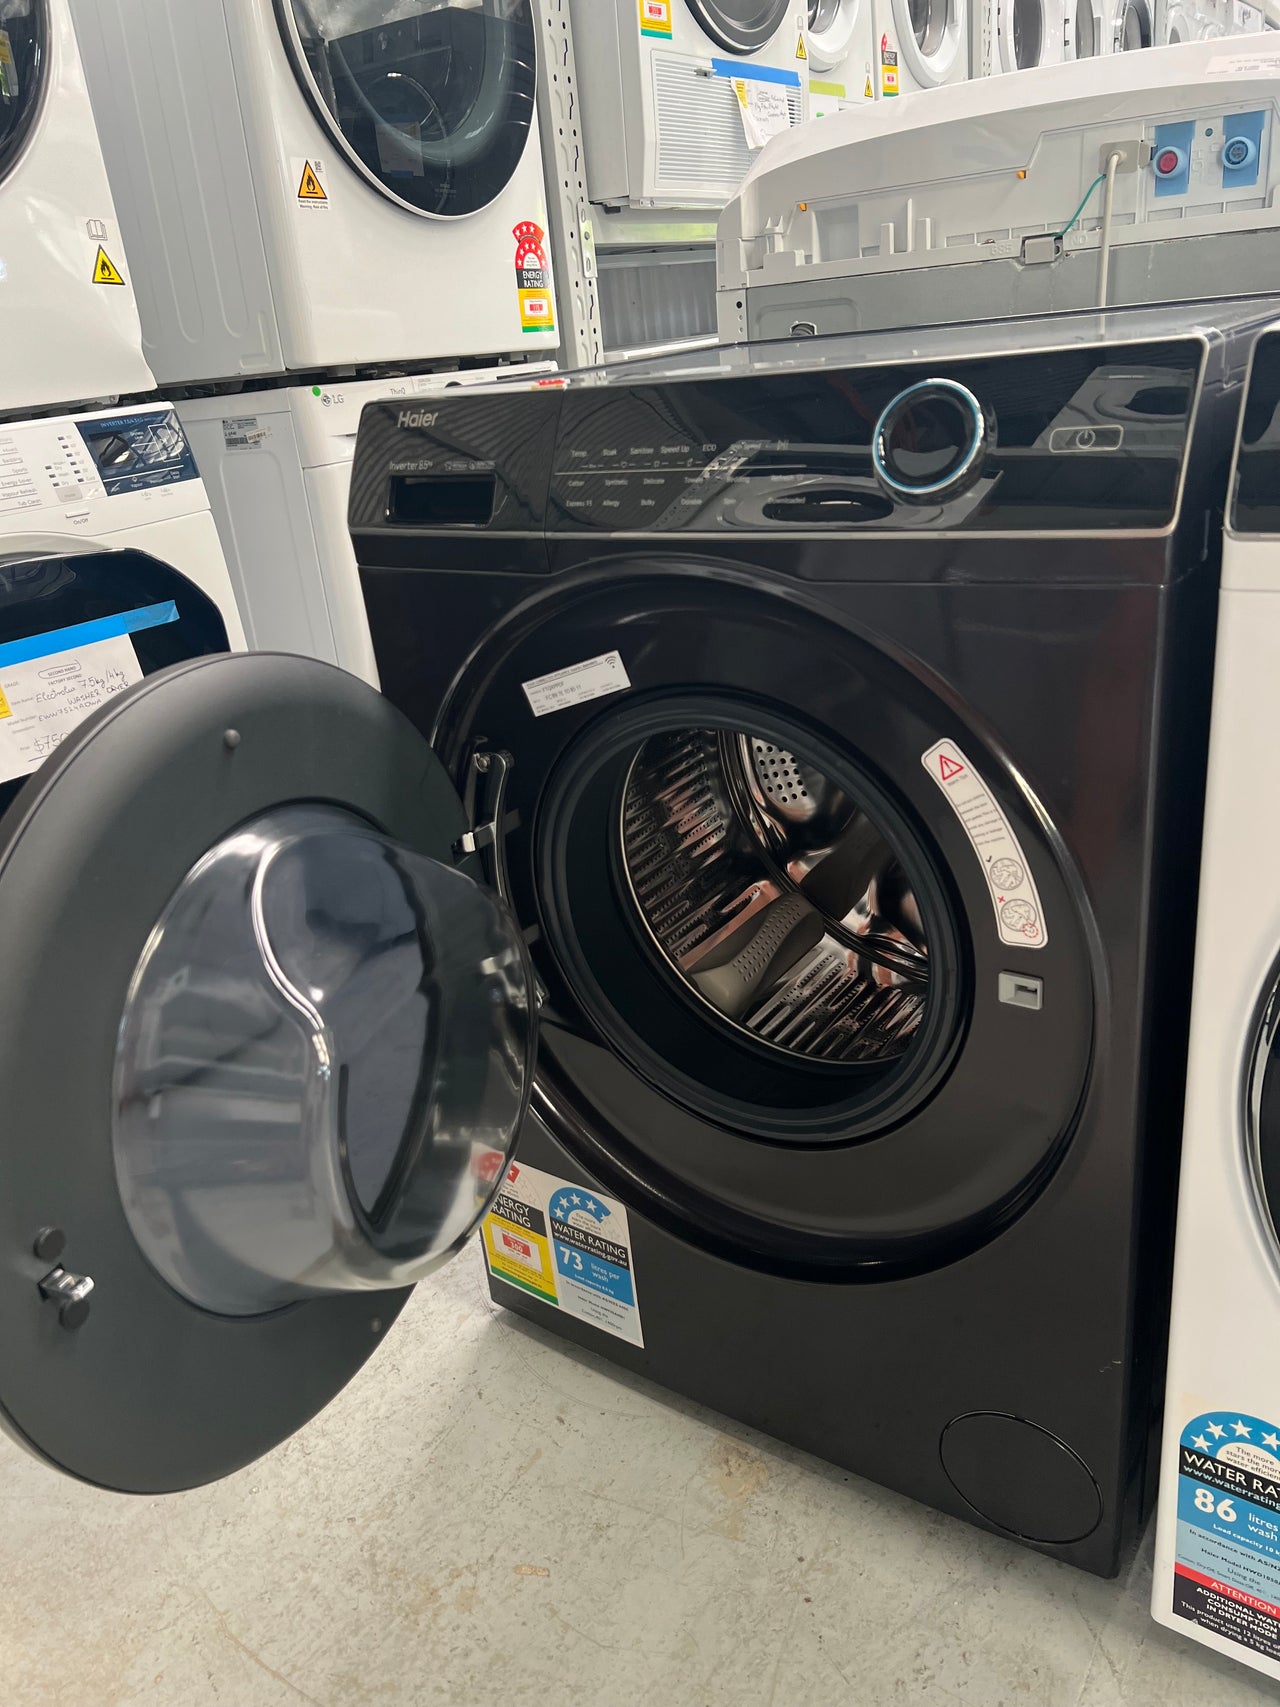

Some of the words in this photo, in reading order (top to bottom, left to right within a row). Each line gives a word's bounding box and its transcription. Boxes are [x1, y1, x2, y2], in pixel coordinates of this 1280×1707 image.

[522, 270, 543, 280] ENERGY
[523, 280, 544, 289] RATING
[332, 394, 345, 404] LG
[398, 410, 439, 429] Haier
[661, 446, 680, 454] Speed
[702, 443, 717, 452] ECO
[389, 461, 418, 472] Inverter
[73, 518, 89, 526] On/Off
[67, 689, 101, 706] WASHER
[498, 1195, 530, 1215] NERGY
[493, 1204, 531, 1228] RATING
[552, 1221, 587, 1243] WATER
[588, 1235, 627, 1259] RATING
[554, 1232, 628, 1267] www.waterrating.gov.au
[560, 1246, 584, 1271] 73
[591, 1262, 608, 1276] litres
[609, 1272, 621, 1282] per
[592, 1272, 609, 1283] wash
[1226, 1449, 1245, 1461] stars
[1247, 1457, 1260, 1467] the
[1226, 1456, 1249, 1469] water
[1236, 1446, 1251, 1458] The
[1253, 1454, 1275, 1466] more
[1184, 1450, 1247, 1486] WATER
[1194, 1488, 1237, 1523] 86
[1249, 1512, 1279, 1532] litres
[1213, 1524, 1232, 1536] Load
[1233, 1533, 1264, 1550] capacity
[1248, 1524, 1278, 1542] wash
[1189, 1529, 1197, 1537] In
[1198, 1533, 1239, 1554] accordance
[1240, 1551, 1257, 1561] with
[1201, 1548, 1220, 1560] Haier
[1221, 1556, 1242, 1569] Model
[1227, 1567, 1247, 1582] Using
[1196, 1587, 1255, 1617] ADDITIONAL
[1211, 1581, 1277, 1615] ATTENTION
[1181, 1601, 1196, 1612] This
[1197, 1607, 1224, 1625] product
[1225, 1622, 1241, 1633] uses
[1244, 1629, 1251, 1638] 12
[1206, 1604, 1217, 1614] IN
[1218, 1609, 1248, 1627] DRYER
[1250, 1624, 1278, 1640] MODE
[1208, 1599, 1278, 1633] CONSUMPTION
[1201, 1617, 1219, 1629] when
[1221, 1625, 1243, 1642] drying
